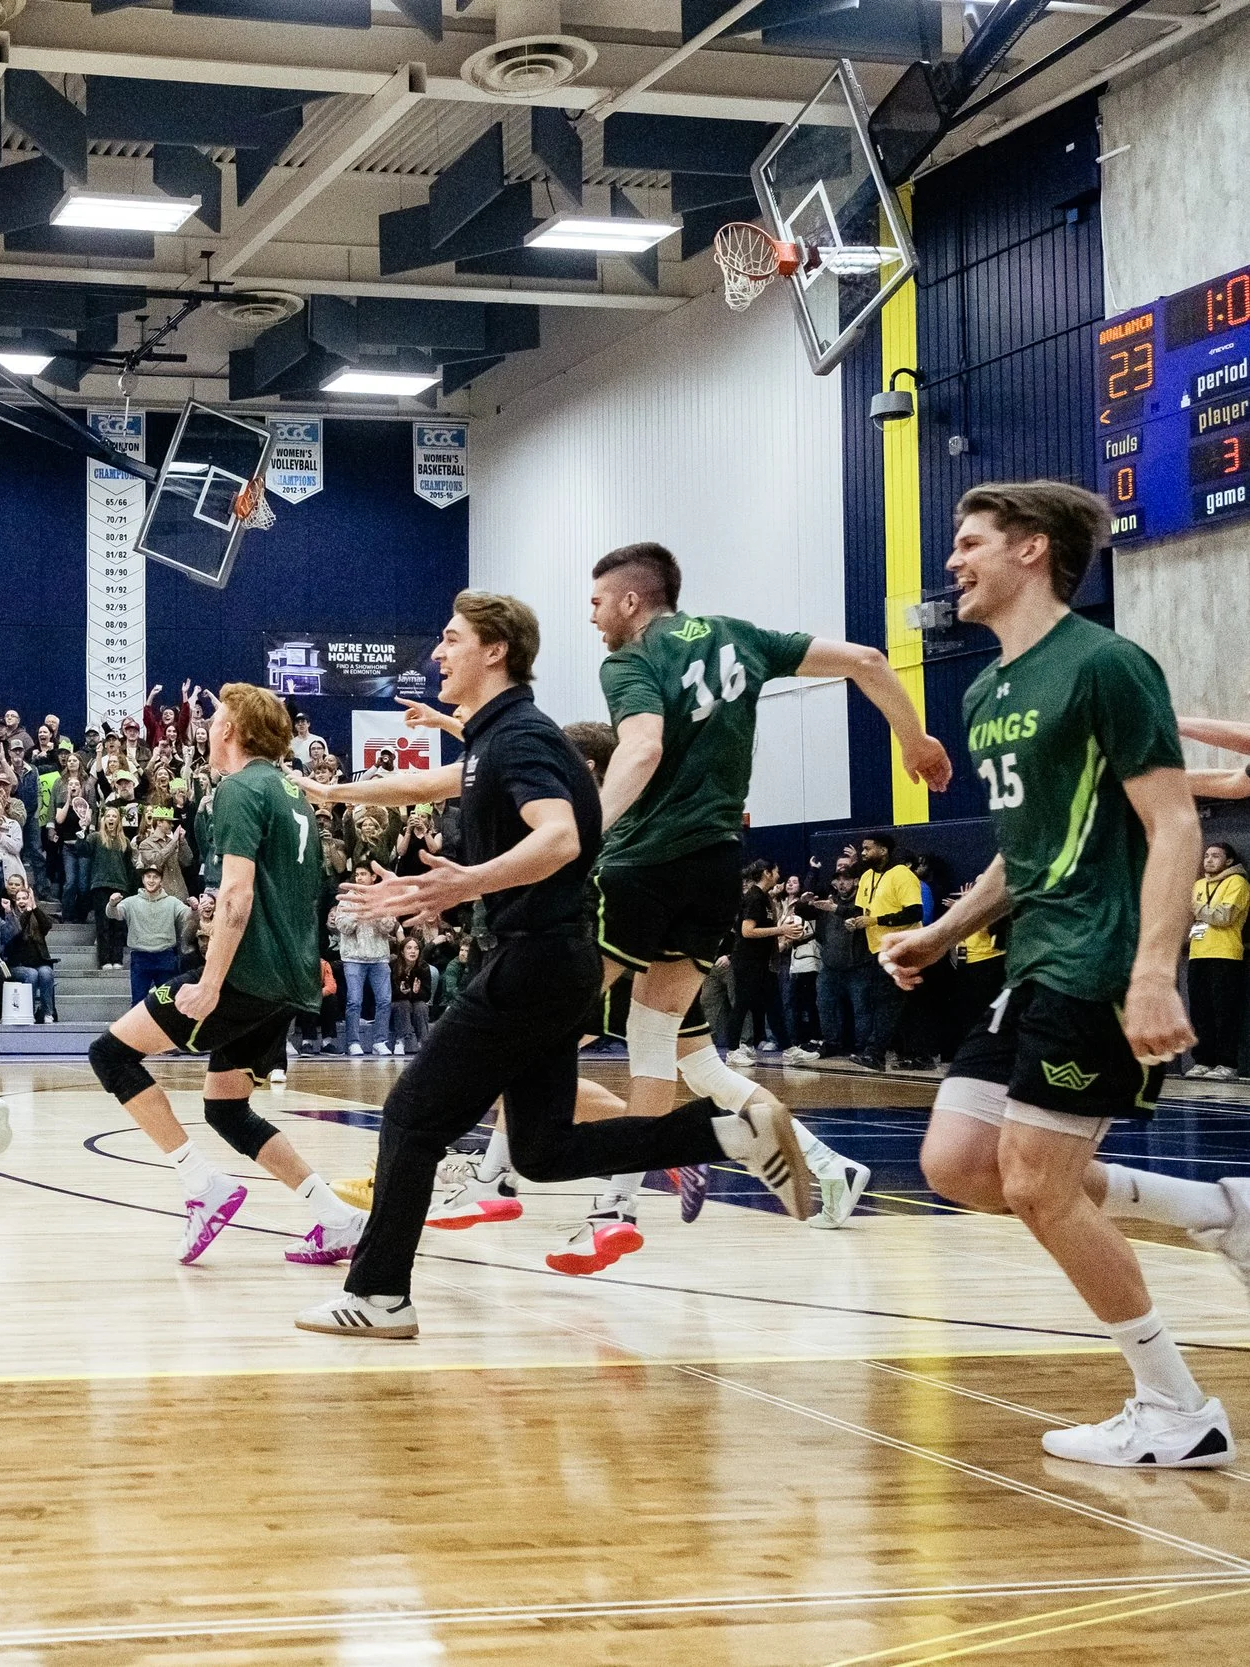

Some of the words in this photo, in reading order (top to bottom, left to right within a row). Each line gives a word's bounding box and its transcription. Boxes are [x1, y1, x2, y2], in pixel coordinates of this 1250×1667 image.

[1108, 342, 1153, 399] 23
[1197, 358, 1248, 397] period
[1199, 399, 1248, 433] player
[1106, 434, 1137, 459] fouls
[276, 448, 312, 458] WOMEN'S
[423, 454, 458, 463] WOMEN'S
[1223, 437, 1239, 474] 3
[271, 459, 317, 471] VOLLEYBALL
[418, 464, 465, 476] BASKETBALL
[420, 480, 463, 491] CHAMPIONS
[1117, 467, 1132, 501] 0
[105, 498, 127, 506] 65/66
[1206, 486, 1245, 516] game
[106, 516, 127, 524] 70/71
[1110, 514, 1137, 535] won
[105, 568, 127, 576] 89/90
[106, 586, 127, 594] 91/92
[106, 603, 127, 611] 92/93
[105, 638, 127, 646] 09/10
[328, 642, 362, 653] WE'RE
[365, 643, 396, 654] YOUR
[106, 656, 126, 664] 10/11
[328, 653, 360, 662] HOME
[362, 653, 396, 663] TEAM.
[397, 674, 426, 684] Jayman
[681, 643, 746, 723] 16
[968, 709, 1040, 752] KINGS
[977, 752, 1024, 810] 15
